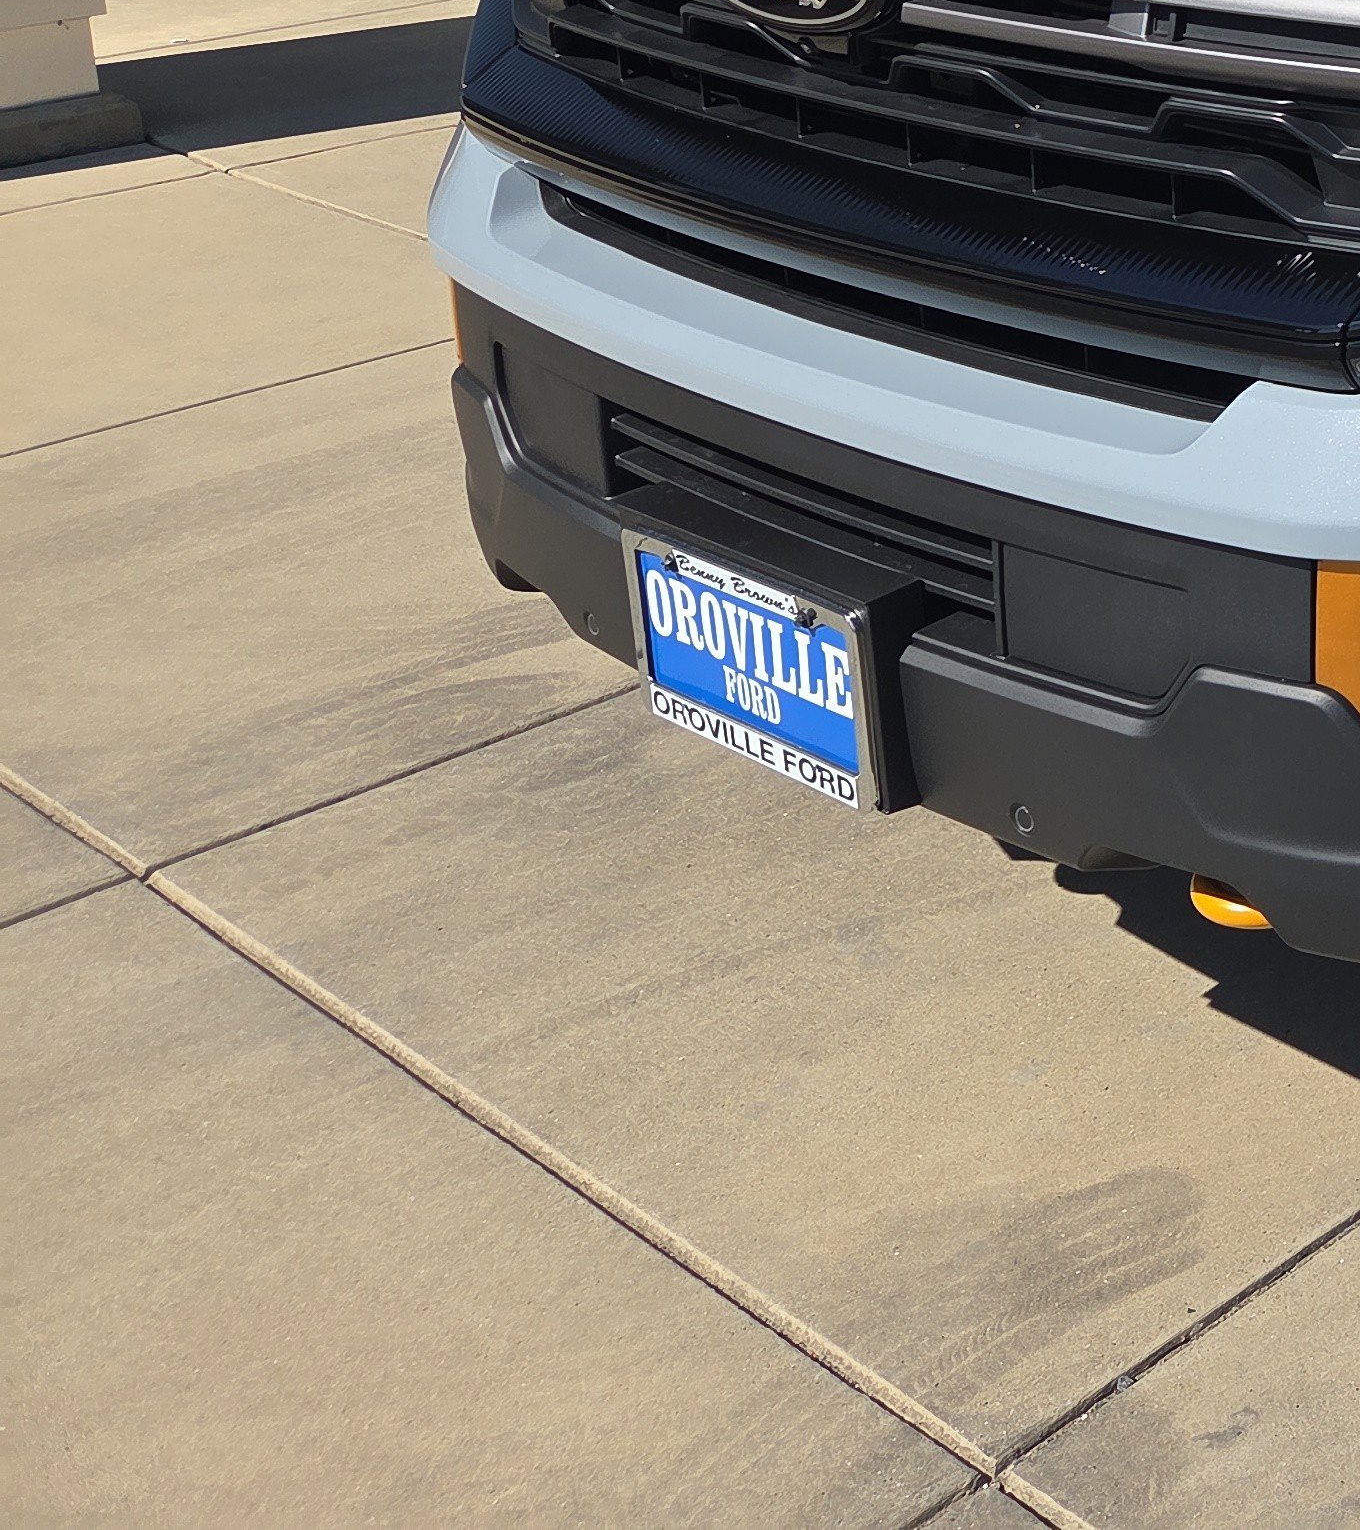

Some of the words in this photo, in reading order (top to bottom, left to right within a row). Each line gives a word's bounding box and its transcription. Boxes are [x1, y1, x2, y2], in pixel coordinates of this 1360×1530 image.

[676, 553, 726, 591] Benny
[730, 576, 799, 616] Brown's
[646, 568, 854, 720] OROVILLE
[722, 664, 781, 725] FORD
[653, 690, 776, 766] OROVILLE
[783, 749, 855, 802] FORD
